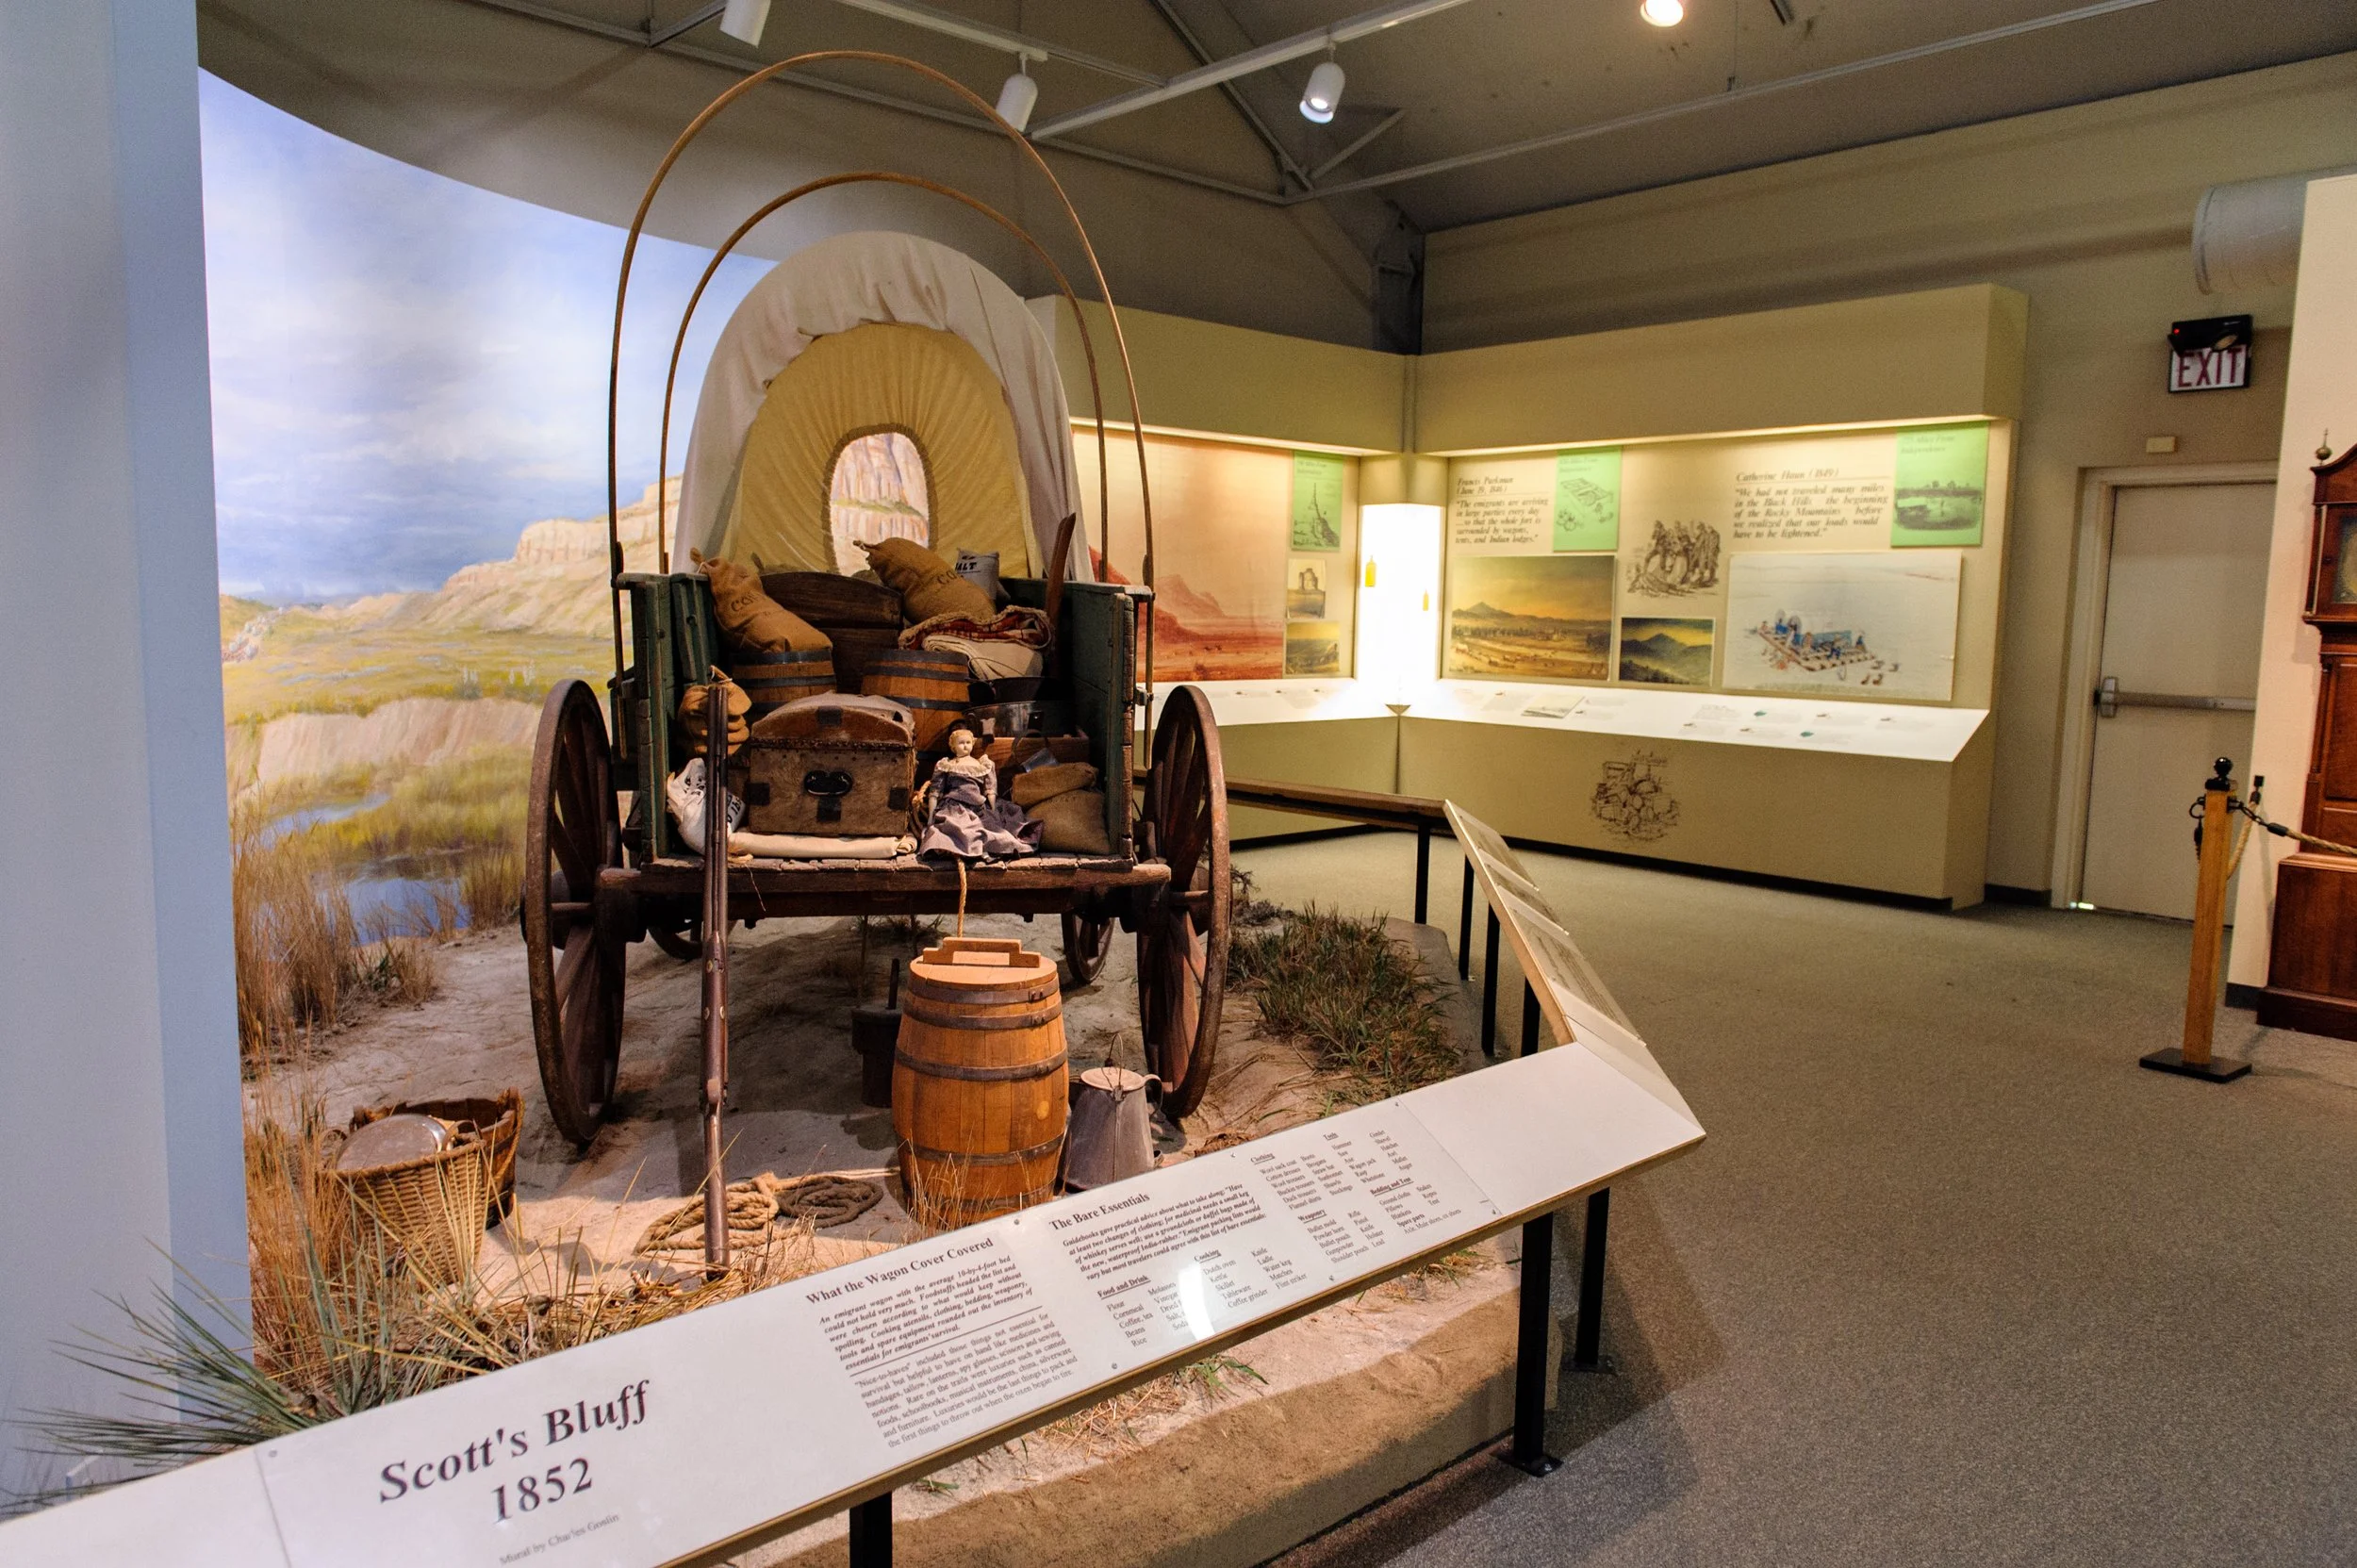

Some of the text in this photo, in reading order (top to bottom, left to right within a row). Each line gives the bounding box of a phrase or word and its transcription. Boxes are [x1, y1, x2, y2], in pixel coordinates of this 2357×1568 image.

[2178, 348, 2243, 388] EXIT
[955, 562, 977, 570] ALT
[1370, 1185, 1393, 1195] Bedding
[1049, 1193, 1151, 1230] The Bare Essentials
[1063, 1231, 1099, 1246] Guidebooks
[1099, 1227, 1113, 1236] gave
[1113, 1216, 1140, 1232] practical
[1140, 1212, 1158, 1222] advice
[1159, 1206, 1175, 1215] about
[1175, 1201, 1189, 1210] what
[1297, 1210, 1327, 1221] Weaponry
[1108, 1246, 1141, 1263] waterproof
[1182, 1223, 1210, 1236] Emigrant
[1210, 1216, 1233, 1229] packing
[1244, 1204, 1261, 1214] would
[806, 1237, 994, 1304] What the Wagon Cover Covered
[1194, 1249, 1222, 1262] Cooking
[824, 1321, 845, 1333] could
[847, 1317, 859, 1326] not
[860, 1310, 877, 1321] hold
[894, 1298, 914, 1310] much.
[919, 1285, 955, 1301] Foodstuffs
[956, 1275, 981, 1288] headed
[992, 1268, 1003, 1277] list
[1004, 1263, 1016, 1273] and
[834, 1304, 866, 1319] emigrant
[869, 1296, 893, 1307] wagon
[897, 1289, 912, 1297] with
[929, 1275, 954, 1288] average
[998, 1255, 1011, 1264] bed
[1097, 1275, 1148, 1297] Food and Drink
[830, 1332, 847, 1342] were
[852, 1322, 878, 1334] chosen
[882, 1308, 917, 1324] according
[933, 1296, 949, 1306] what
[954, 1287, 974, 1299] would
[978, 1282, 994, 1291] keep
[997, 1272, 1022, 1284] without
[834, 1281, 1028, 1351] spoiling. Cooking utensils, clothing, bedding, weaponry,
[840, 1350, 858, 1362] tools
[861, 1343, 875, 1354] and
[877, 1337, 896, 1347] spare
[898, 1323, 935, 1340] equipment
[937, 1311, 965, 1326] rounded
[967, 1307, 979, 1315] out
[993, 1293, 1023, 1306] inventory
[1025, 1287, 1032, 1296] of
[1107, 1301, 1125, 1312] Flour
[1113, 1304, 1145, 1320] Cornmeal
[916, 1350, 947, 1366] included
[948, 1344, 967, 1354] those
[970, 1335, 992, 1345] things
[1009, 1317, 1036, 1331] essential
[1125, 1328, 1146, 1338] Beans
[1130, 1337, 1147, 1347] Rice
[846, 1354, 881, 1370] essentials
[882, 1348, 892, 1359] for
[861, 1382, 891, 1398] survival
[892, 1378, 905, 1386] but
[906, 1366, 932, 1381] helpful
[944, 1357, 962, 1367] have
[974, 1344, 992, 1356] hand
[993, 1340, 1007, 1348] like
[1009, 1328, 1041, 1343] medicines
[1044, 1321, 1055, 1330] and
[379, 1379, 650, 1503] Scott's Bluff
[491, 1457, 593, 1524] 1852
[532, 1542, 546, 1553] by
[548, 1526, 586, 1547] Charles
